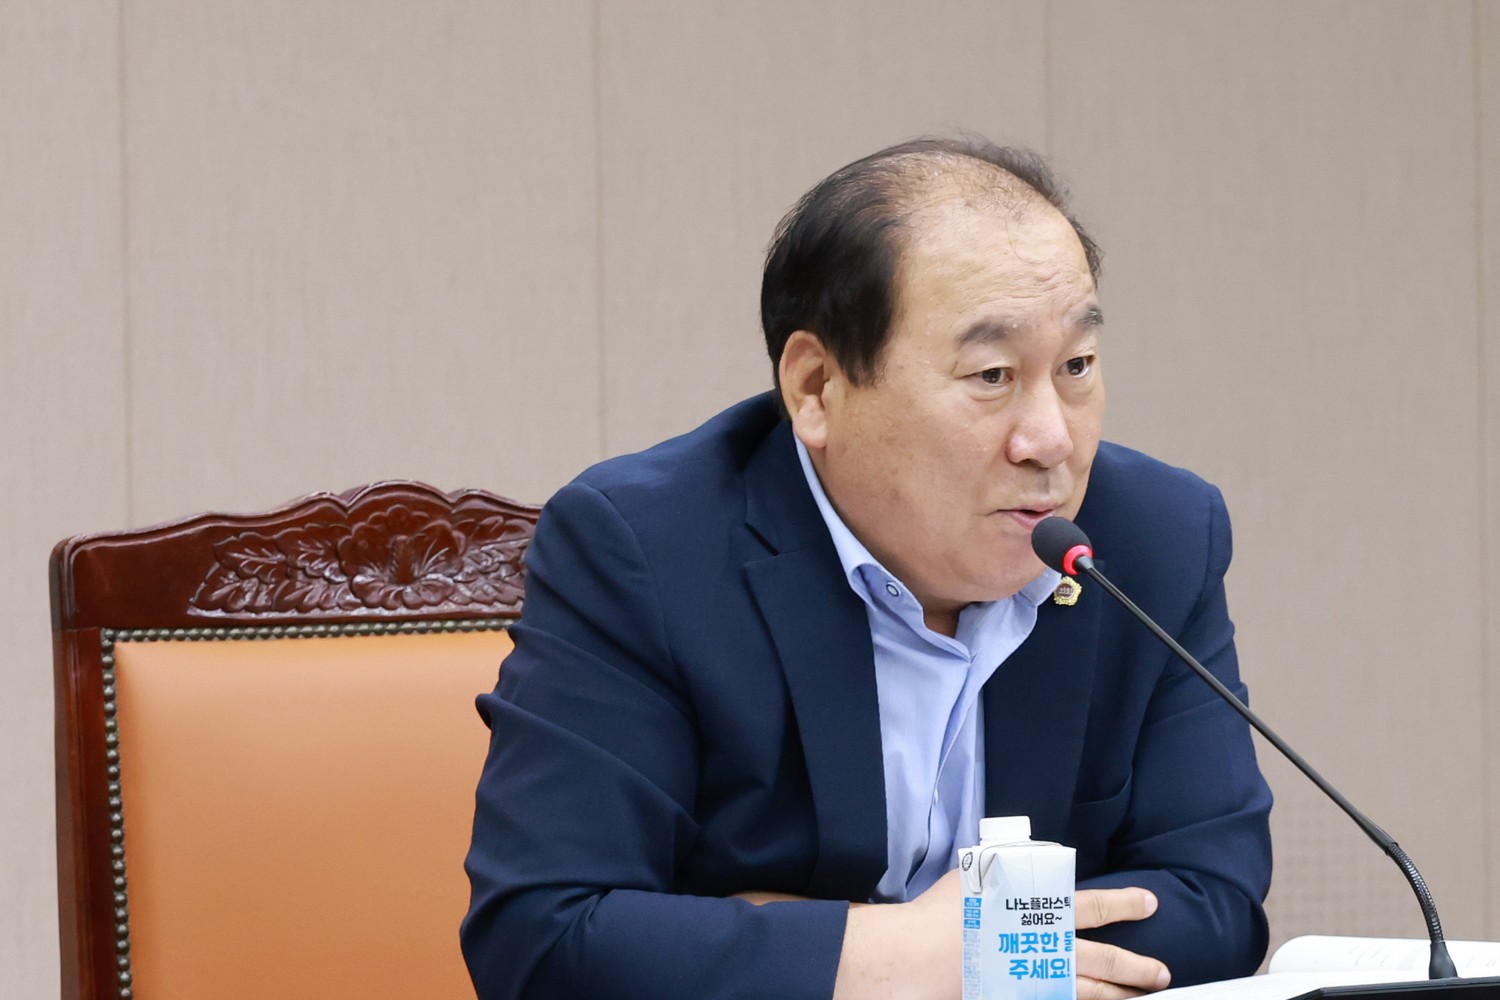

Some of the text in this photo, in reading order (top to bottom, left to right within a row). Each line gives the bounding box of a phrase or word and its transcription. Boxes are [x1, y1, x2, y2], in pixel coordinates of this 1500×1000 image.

[1005, 896, 1071, 911] 나노플라스틱
[1020, 912, 1063, 926] 싫어요~
[998, 932, 1059, 954] 깨끗한
[1008, 957, 1070, 981] 주세요!
